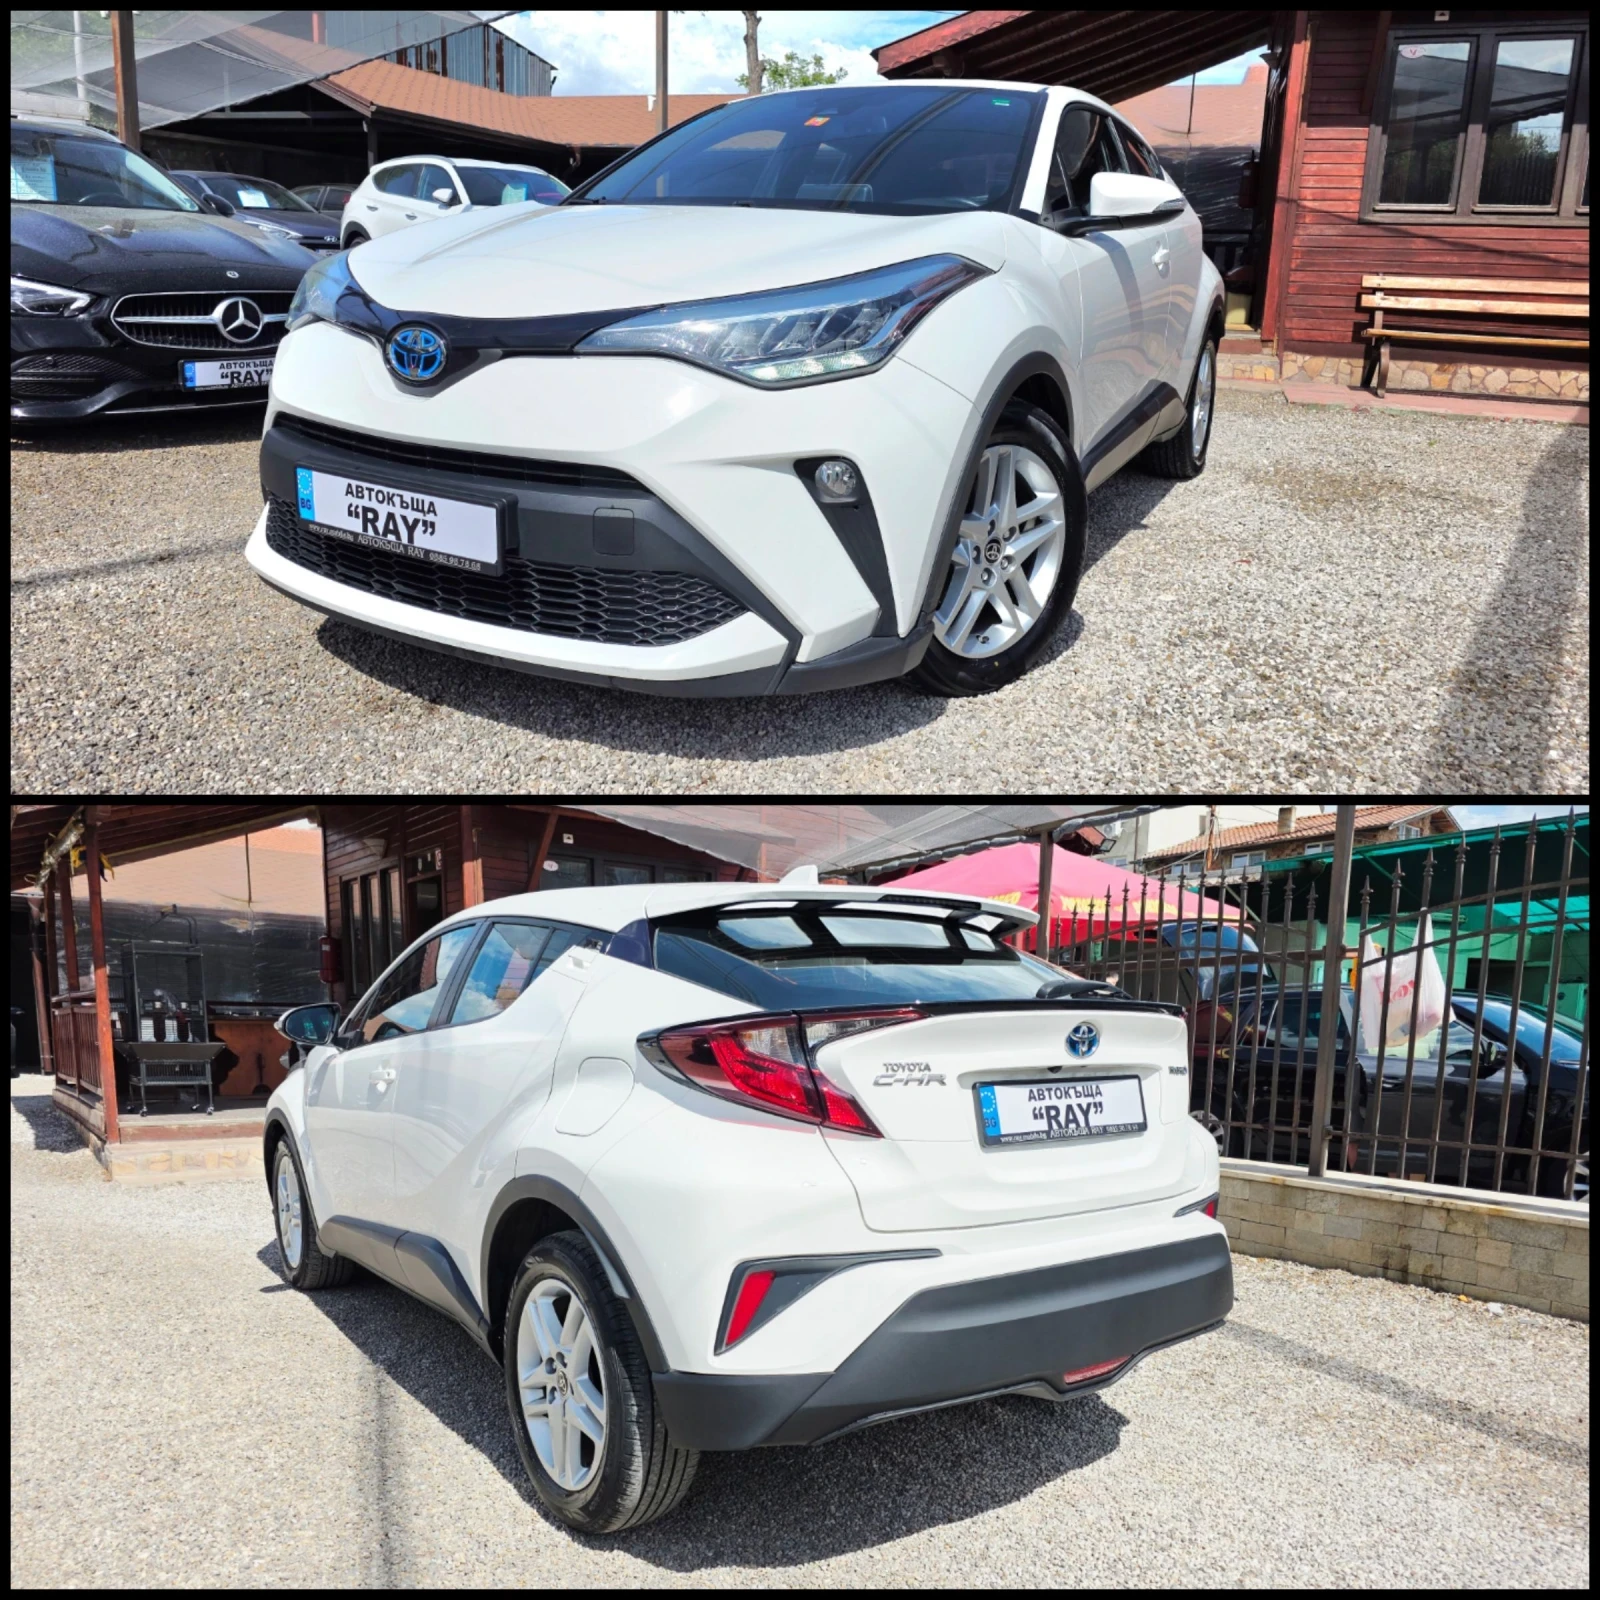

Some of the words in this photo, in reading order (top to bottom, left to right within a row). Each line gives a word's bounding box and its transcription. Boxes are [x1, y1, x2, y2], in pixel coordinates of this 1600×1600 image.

[219, 359, 274, 370] АВТОКЪЩА
[300, 498, 312, 510] BG
[344, 482, 438, 517] АВТОКЪЩА
[347, 502, 436, 545] “RAY”
[358, 534, 405, 554] АВТОКЪЩА
[408, 546, 425, 559] RAY
[883, 1062, 931, 1073] TOYOTA
[873, 1073, 947, 1087] C-HR
[1028, 1085, 1103, 1102] АВТОКЪЩА
[1032, 1101, 1103, 1131] “RAY”
[1050, 1126, 1090, 1139] АВТОКЪЩА
